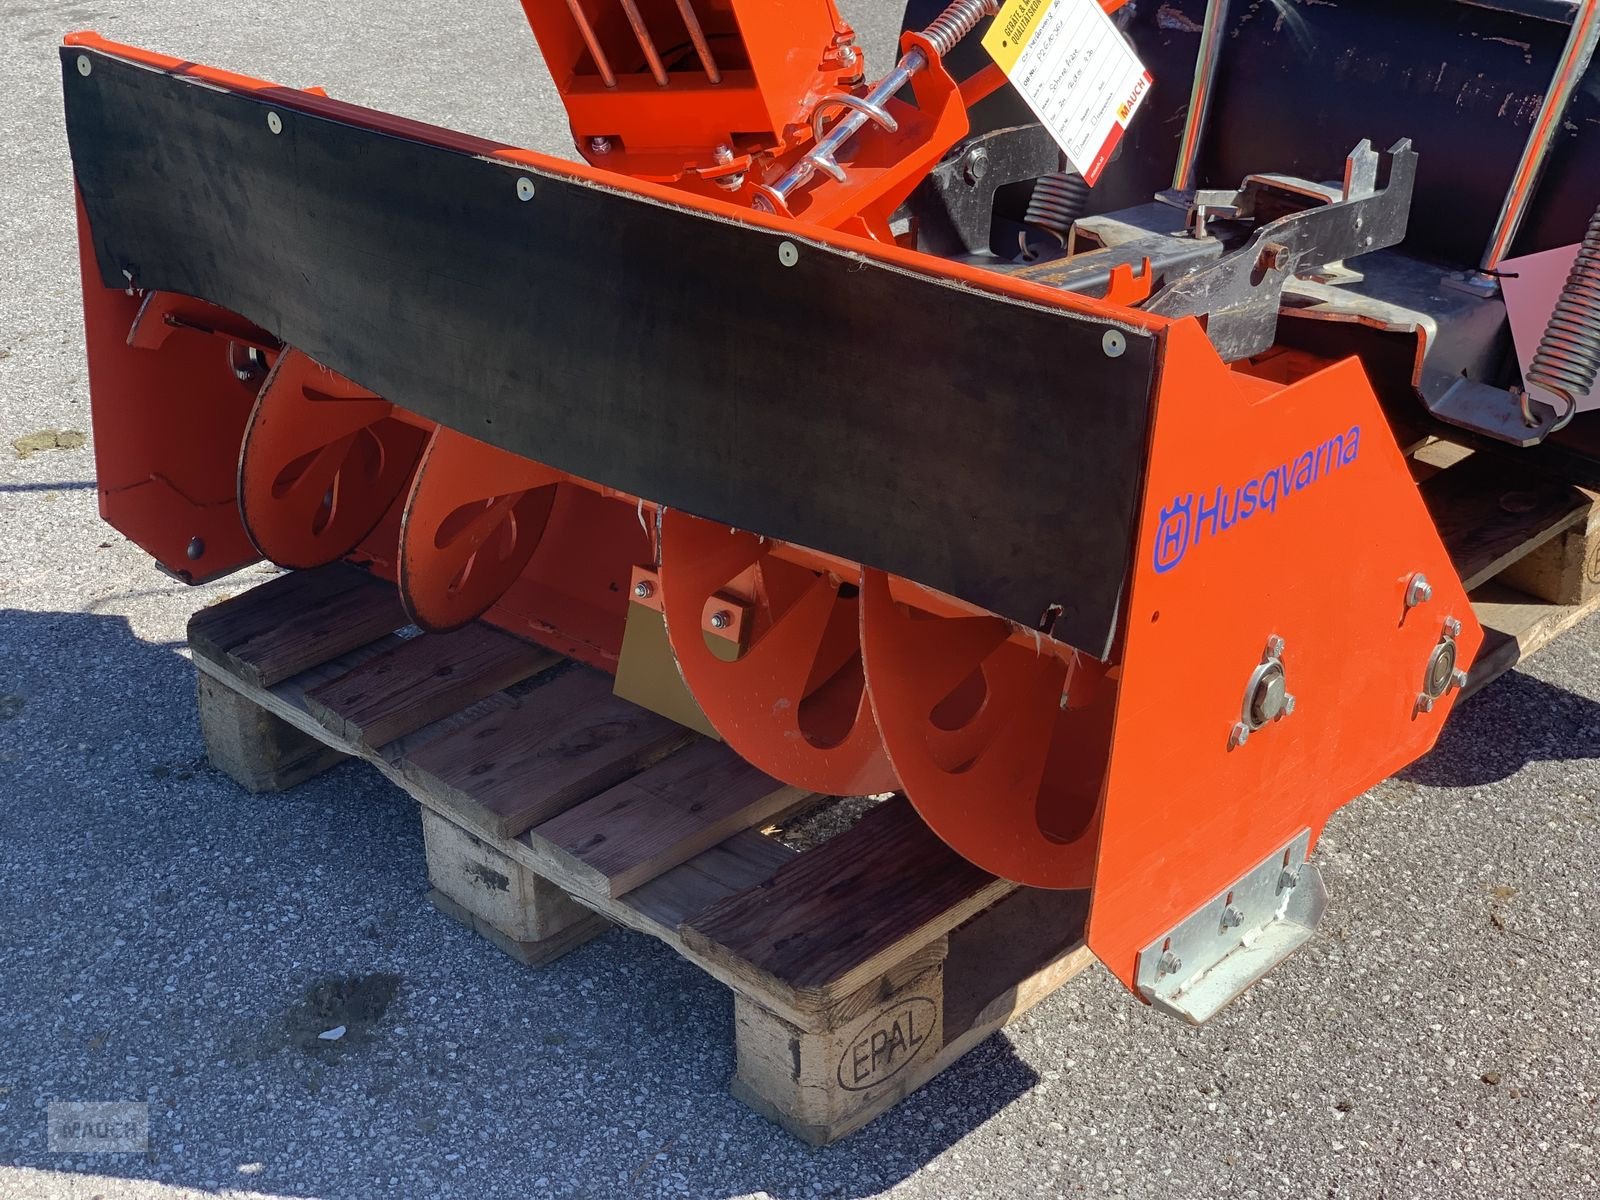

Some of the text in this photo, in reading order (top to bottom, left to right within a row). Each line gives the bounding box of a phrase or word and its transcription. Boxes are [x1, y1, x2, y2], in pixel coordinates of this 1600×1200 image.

[1004, 9, 1021, 37] GERÄTE
[1120, 77, 1146, 119] MAUCH
[1194, 425, 1361, 545] Husqvarna
[852, 1010, 923, 1084] EPAL
